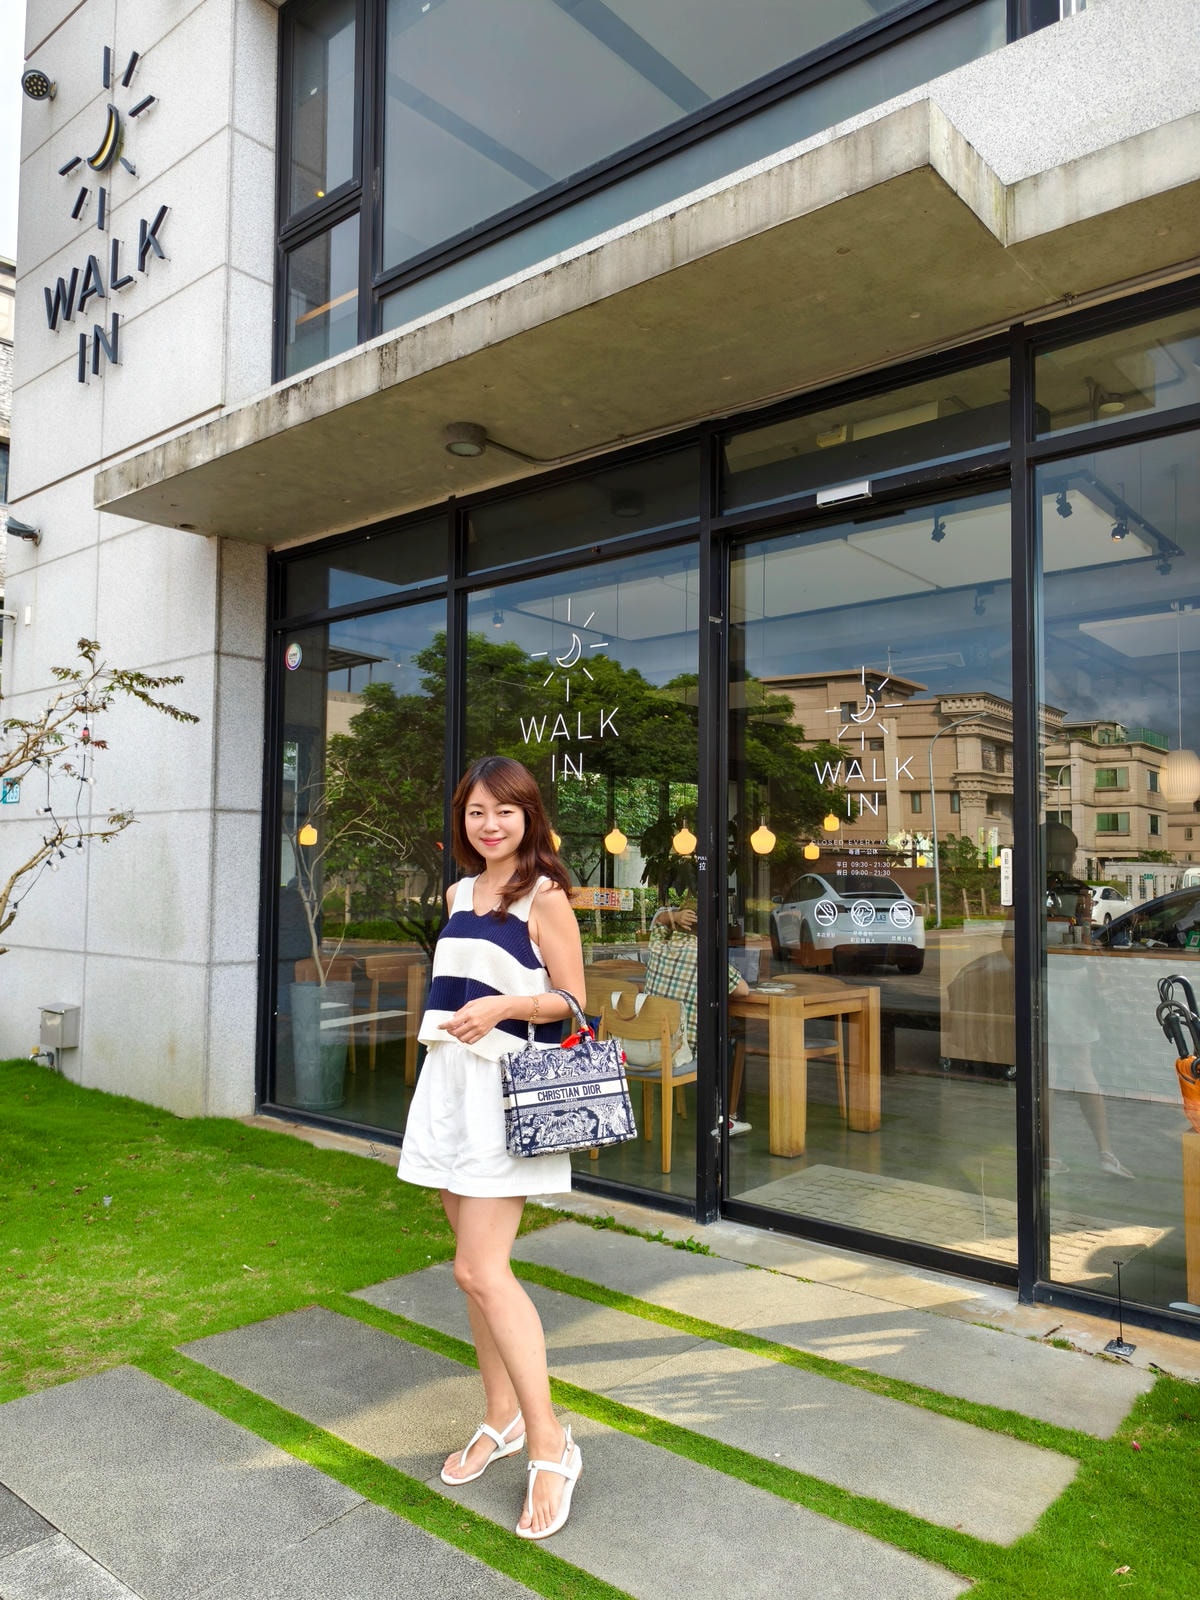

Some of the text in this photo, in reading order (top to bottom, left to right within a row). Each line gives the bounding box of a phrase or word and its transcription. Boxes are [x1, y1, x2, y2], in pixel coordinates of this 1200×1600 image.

[44, 205, 168, 330] WALK
[78, 312, 119, 383] IN
[520, 707, 619, 744] WALK
[552, 752, 583, 782] IN
[814, 755, 914, 785] WALK
[847, 792, 879, 817] IN
[537, 1084, 602, 1102] CHRISTIAN DIOR
